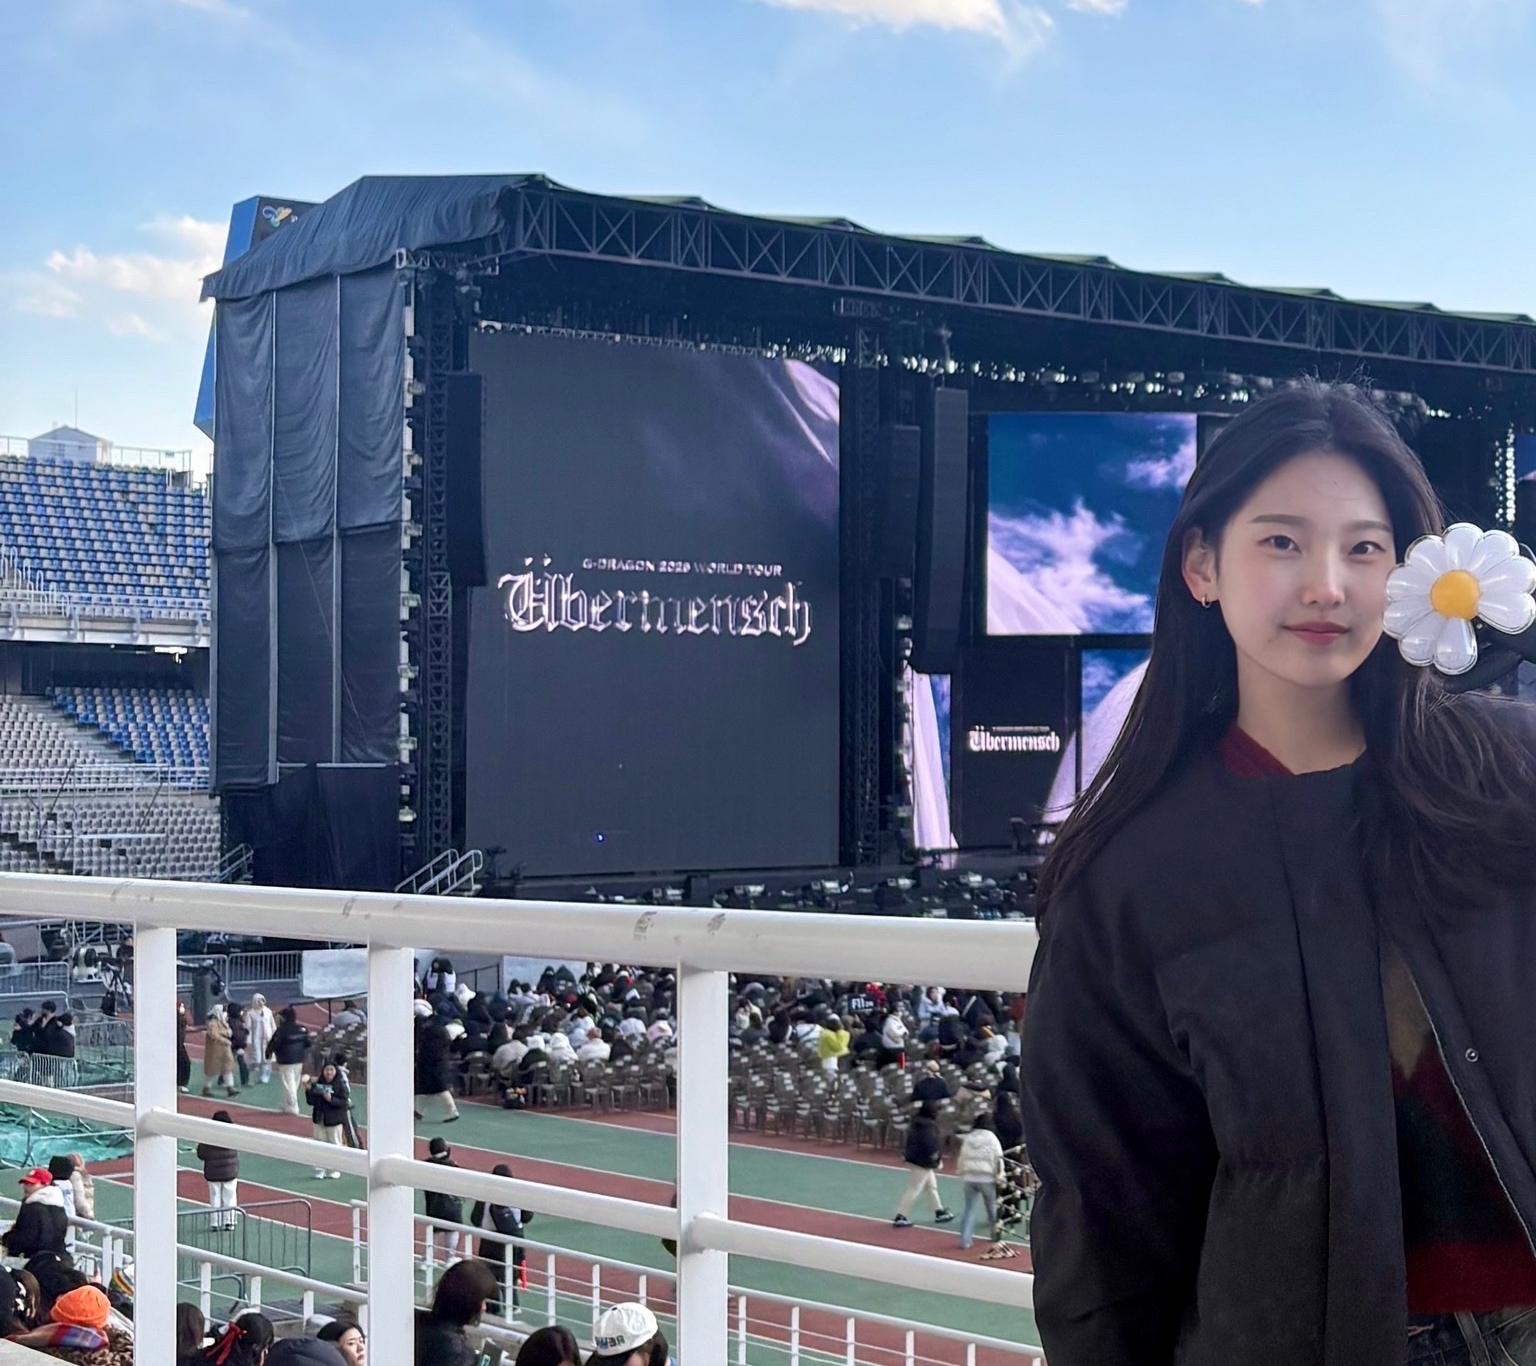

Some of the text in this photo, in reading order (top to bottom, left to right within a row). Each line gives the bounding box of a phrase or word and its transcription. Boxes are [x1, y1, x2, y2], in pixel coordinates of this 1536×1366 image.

[582, 557, 655, 573] G-DRAGON
[693, 561, 744, 575] WORLD
[746, 563, 784, 577] TOUR
[497, 554, 812, 646] Übermensch
[969, 725, 1061, 753] Übermensch
